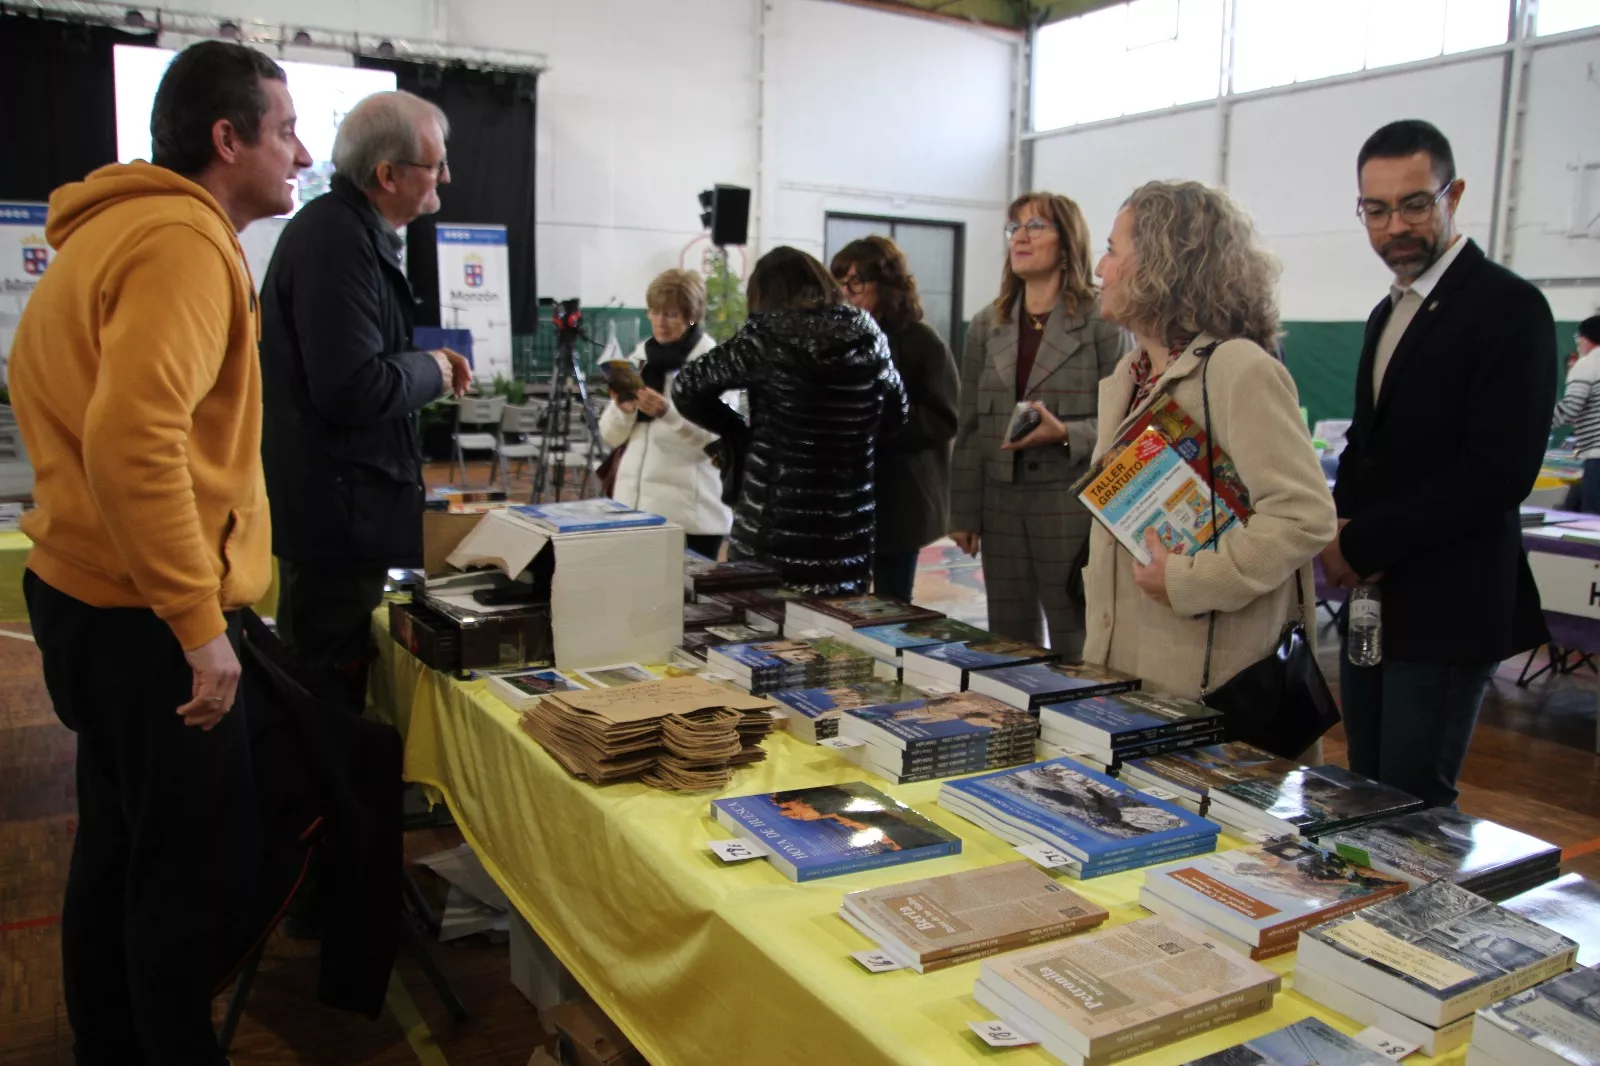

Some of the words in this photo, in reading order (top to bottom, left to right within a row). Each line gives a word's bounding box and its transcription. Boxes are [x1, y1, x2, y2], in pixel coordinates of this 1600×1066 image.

[1090, 463, 1126, 498] TALLER
[1099, 461, 1142, 506] GRATUITO
[727, 802, 764, 828] HUESCA
[760, 827, 781, 838] DE
[776, 839, 809, 859] HOYA
[900, 906, 936, 931] Berta
[1040, 966, 1104, 1010] Petronila
